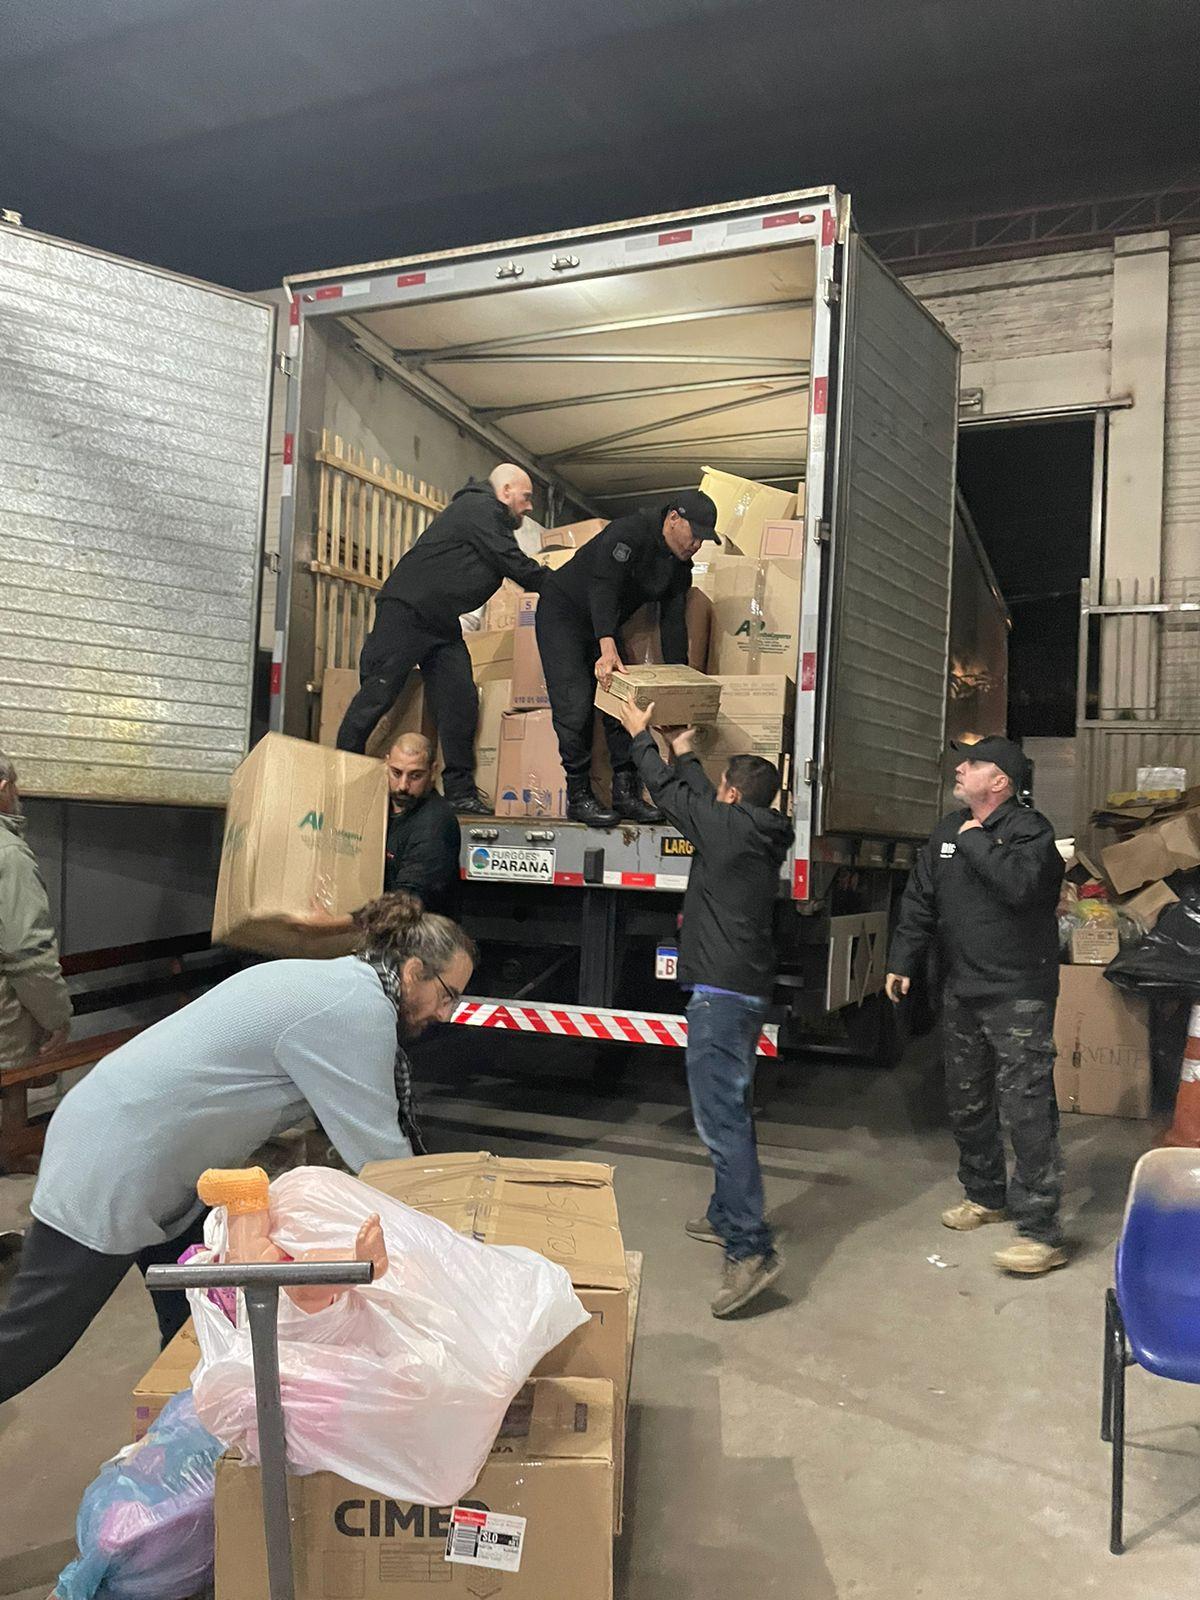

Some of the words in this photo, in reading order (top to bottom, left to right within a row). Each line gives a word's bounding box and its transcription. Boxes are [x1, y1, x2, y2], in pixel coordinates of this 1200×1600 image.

[664, 838, 696, 855] LARG
[491, 859, 549, 874] PARANÁ
[334, 1499, 491, 1537] CIME
